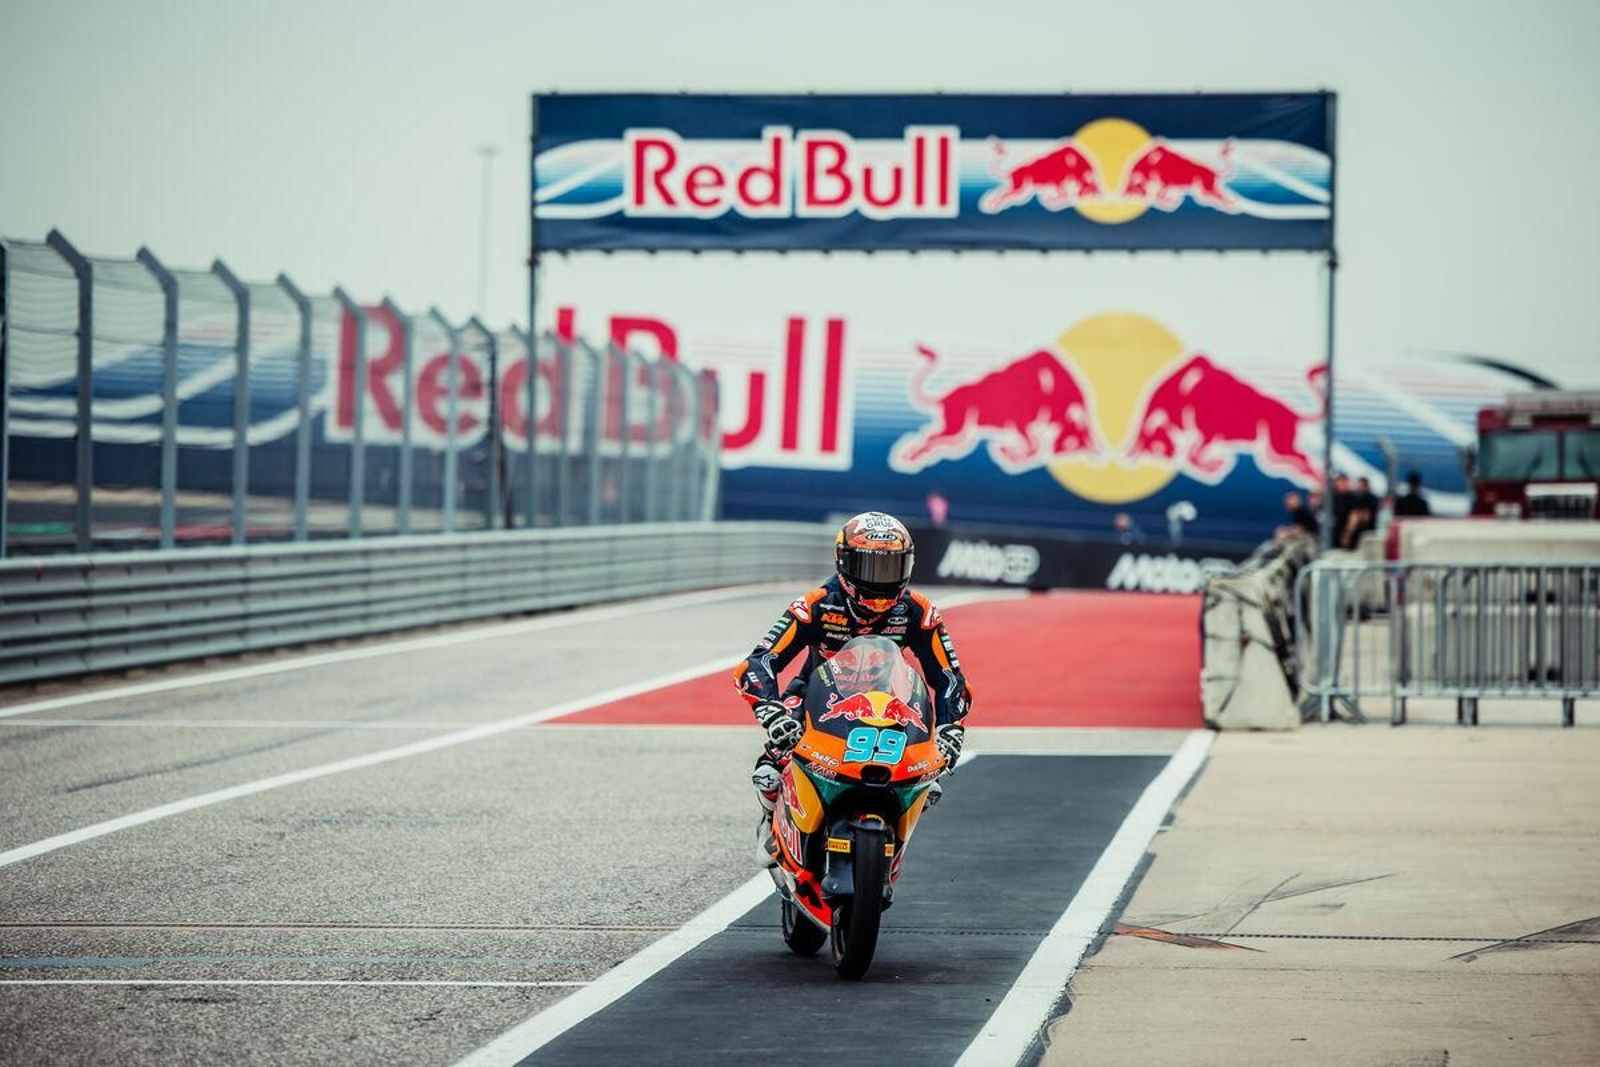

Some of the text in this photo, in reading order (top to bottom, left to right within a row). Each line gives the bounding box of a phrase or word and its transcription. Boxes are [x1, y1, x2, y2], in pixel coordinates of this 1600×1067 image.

[633, 136, 950, 207] Red Bull
[336, 305, 845, 454] Red Bull
[821, 612, 849, 626] KTM
[844, 727, 907, 765] 99
